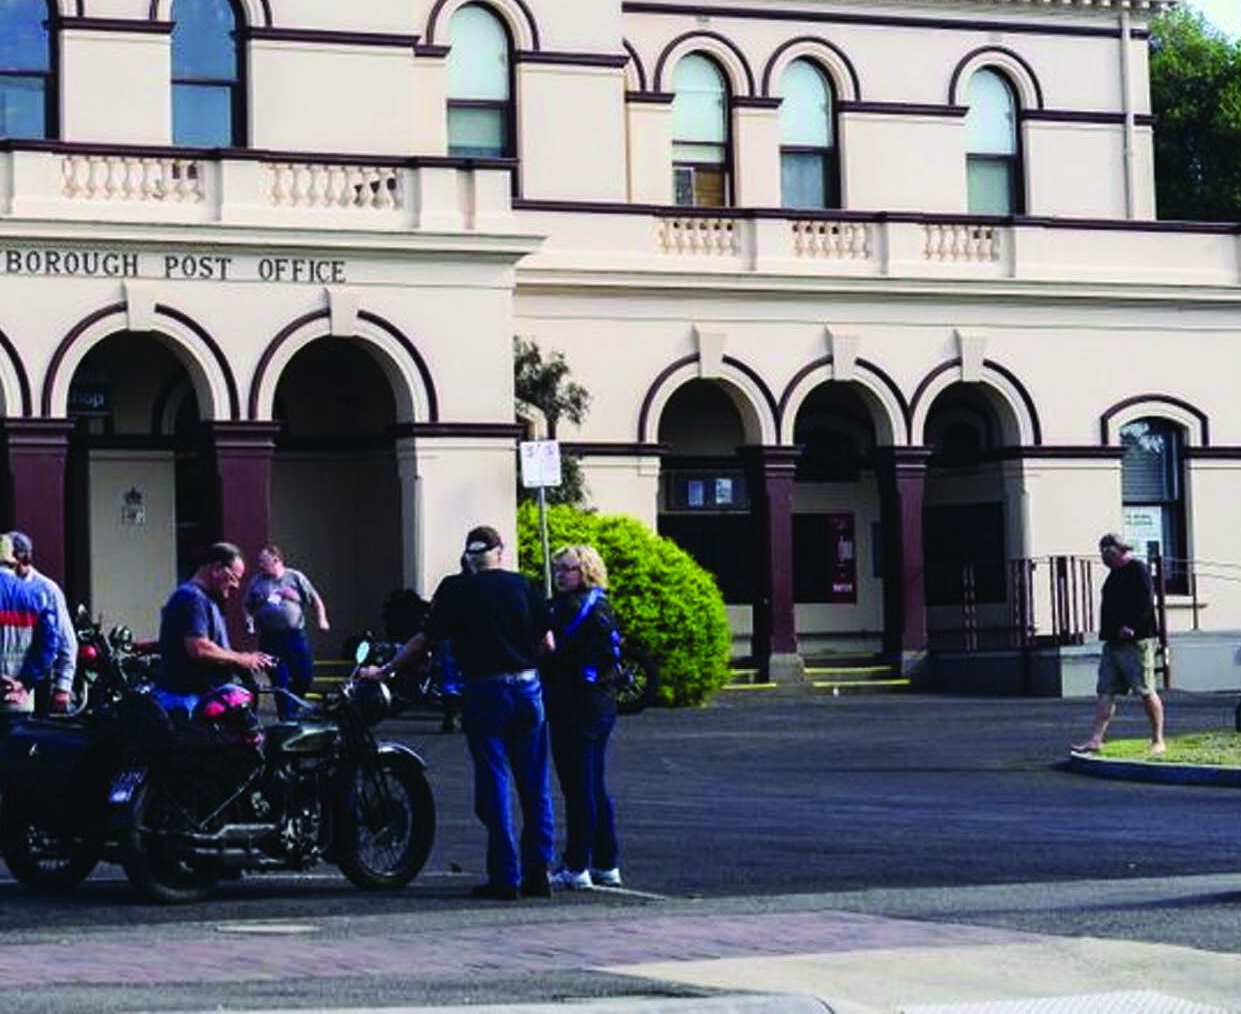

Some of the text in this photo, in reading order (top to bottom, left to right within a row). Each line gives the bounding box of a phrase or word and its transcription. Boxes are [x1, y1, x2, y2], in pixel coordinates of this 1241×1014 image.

[165, 256, 232, 281] POST
[258, 259, 346, 283] OFFICE
[71, 389, 105, 408] hop
